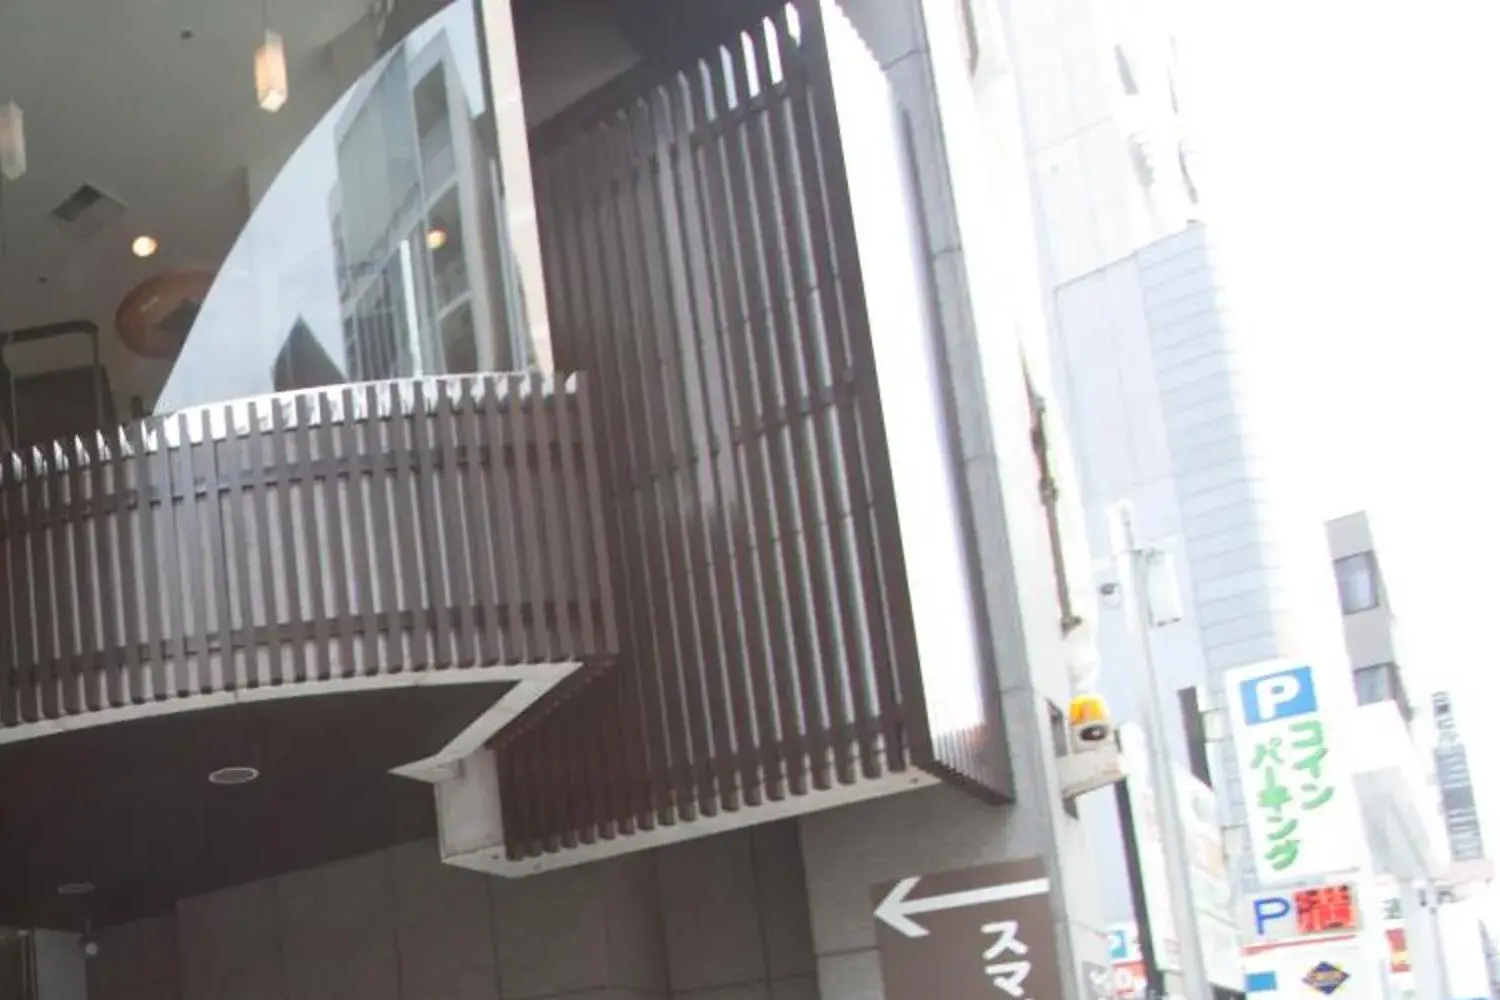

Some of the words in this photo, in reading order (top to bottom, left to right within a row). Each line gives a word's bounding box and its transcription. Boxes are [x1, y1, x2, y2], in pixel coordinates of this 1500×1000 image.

[1255, 675, 1300, 720] P
[1288, 719, 1335, 811] コイン
[1249, 736, 1300, 871] パーキング
[1252, 897, 1291, 935] P
